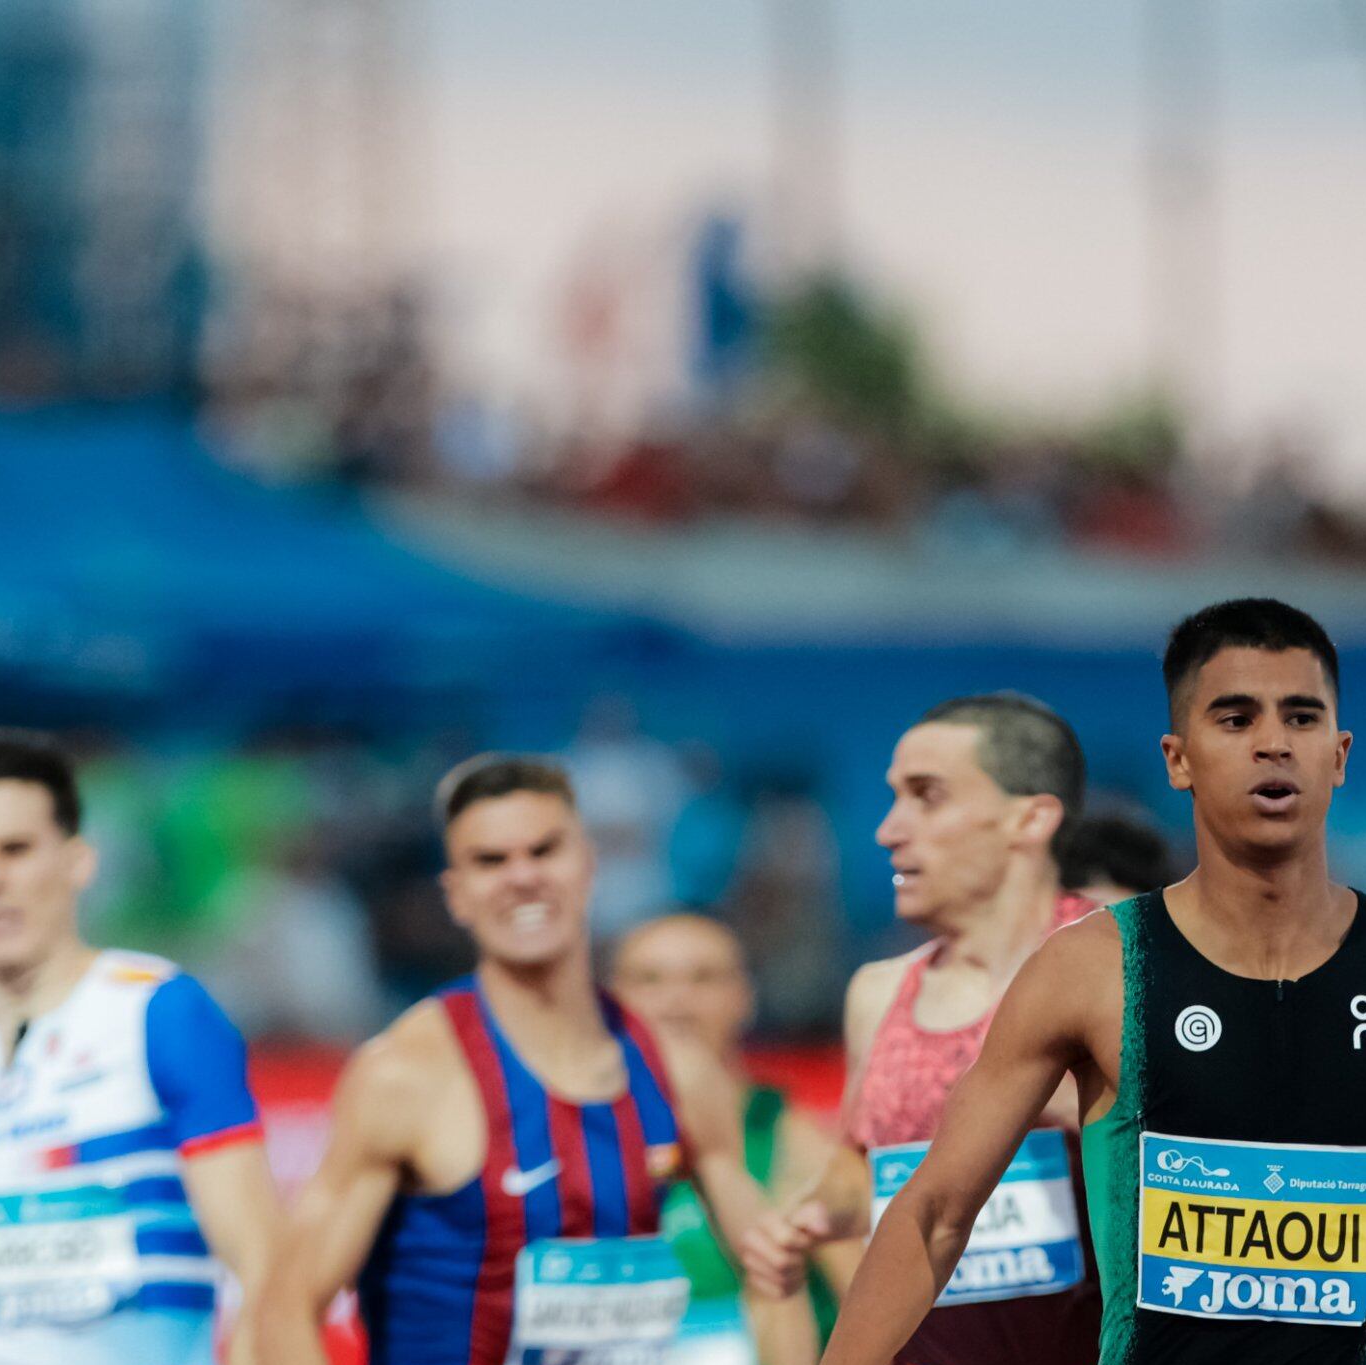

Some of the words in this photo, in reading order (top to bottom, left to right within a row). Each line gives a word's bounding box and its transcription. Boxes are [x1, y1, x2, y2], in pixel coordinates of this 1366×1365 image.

[1147, 1172, 1180, 1186] COSTA
[1182, 1178, 1240, 1192] DAURADA
[1289, 1178, 1336, 1190] Diputació
[1158, 1201, 1360, 1264] ATTAOUI
[1200, 1271, 1356, 1315] Joma
